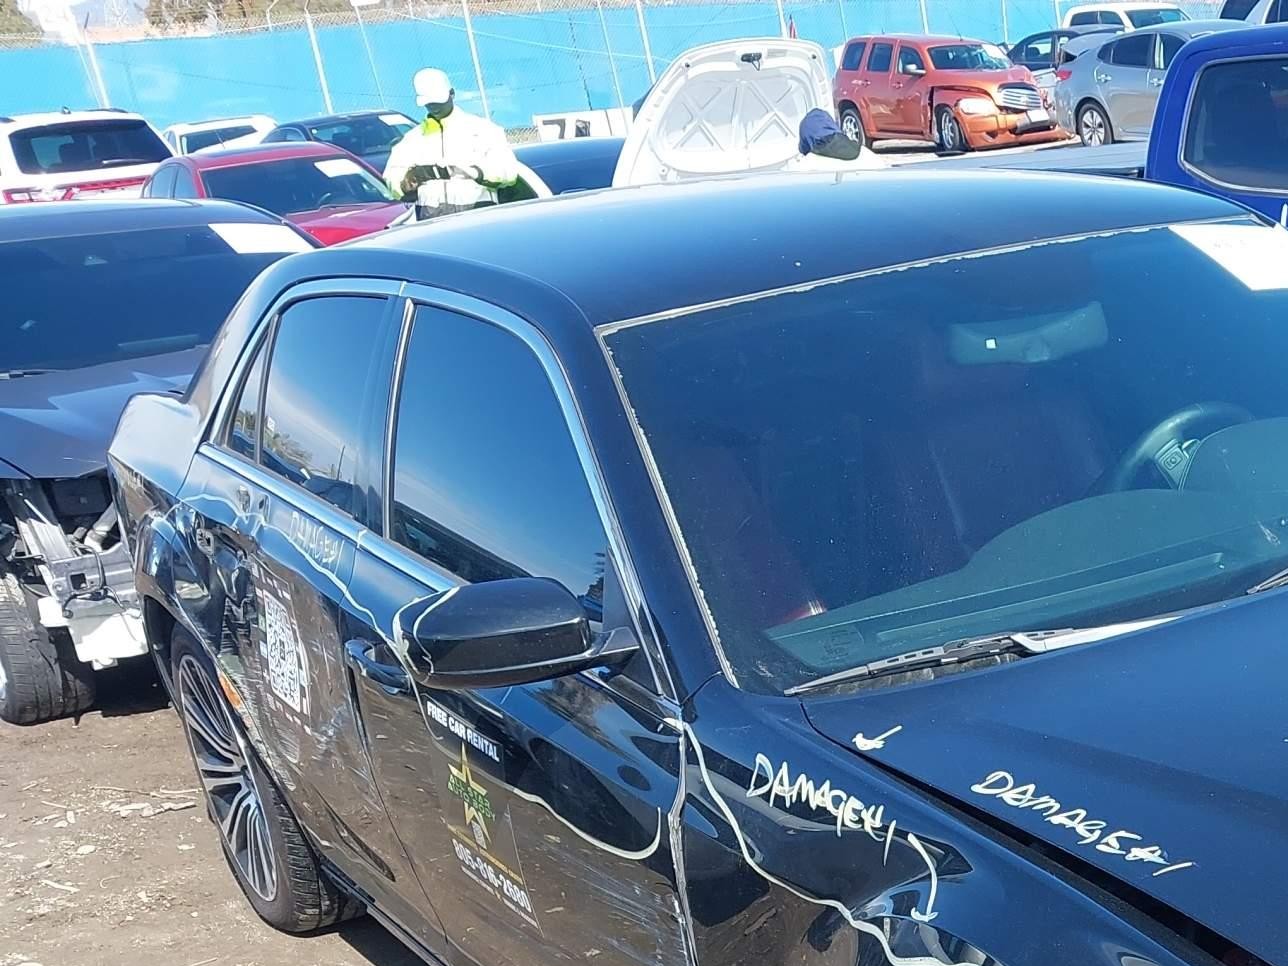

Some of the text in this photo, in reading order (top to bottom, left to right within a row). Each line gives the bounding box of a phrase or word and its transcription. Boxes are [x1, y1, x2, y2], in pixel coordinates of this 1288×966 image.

[426, 699, 500, 762] FREE CAR RENTAL
